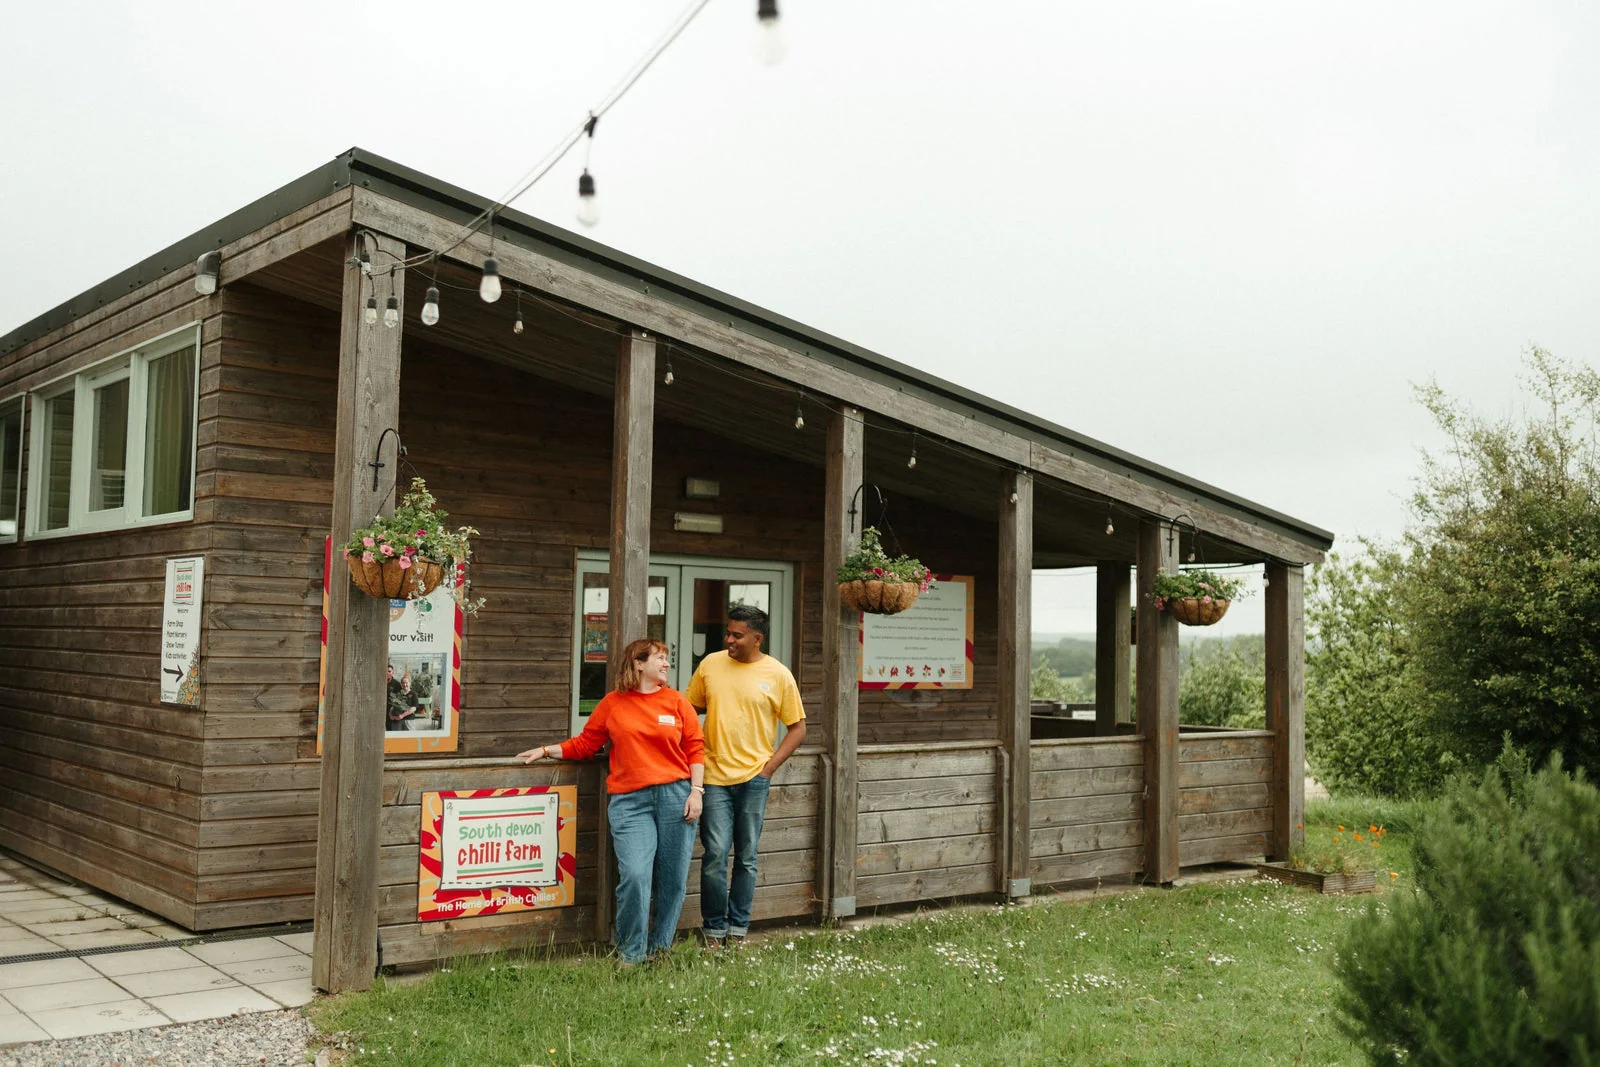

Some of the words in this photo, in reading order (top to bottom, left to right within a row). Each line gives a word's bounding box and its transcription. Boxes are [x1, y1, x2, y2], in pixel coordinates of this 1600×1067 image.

[389, 633, 407, 642] our
[506, 822, 542, 837] devon
[457, 841, 501, 866] chilli
[505, 839, 541, 862] farm
[437, 903, 453, 912] The
[455, 900, 483, 910] Home
[485, 898, 494, 907] of
[496, 895, 524, 907] British
